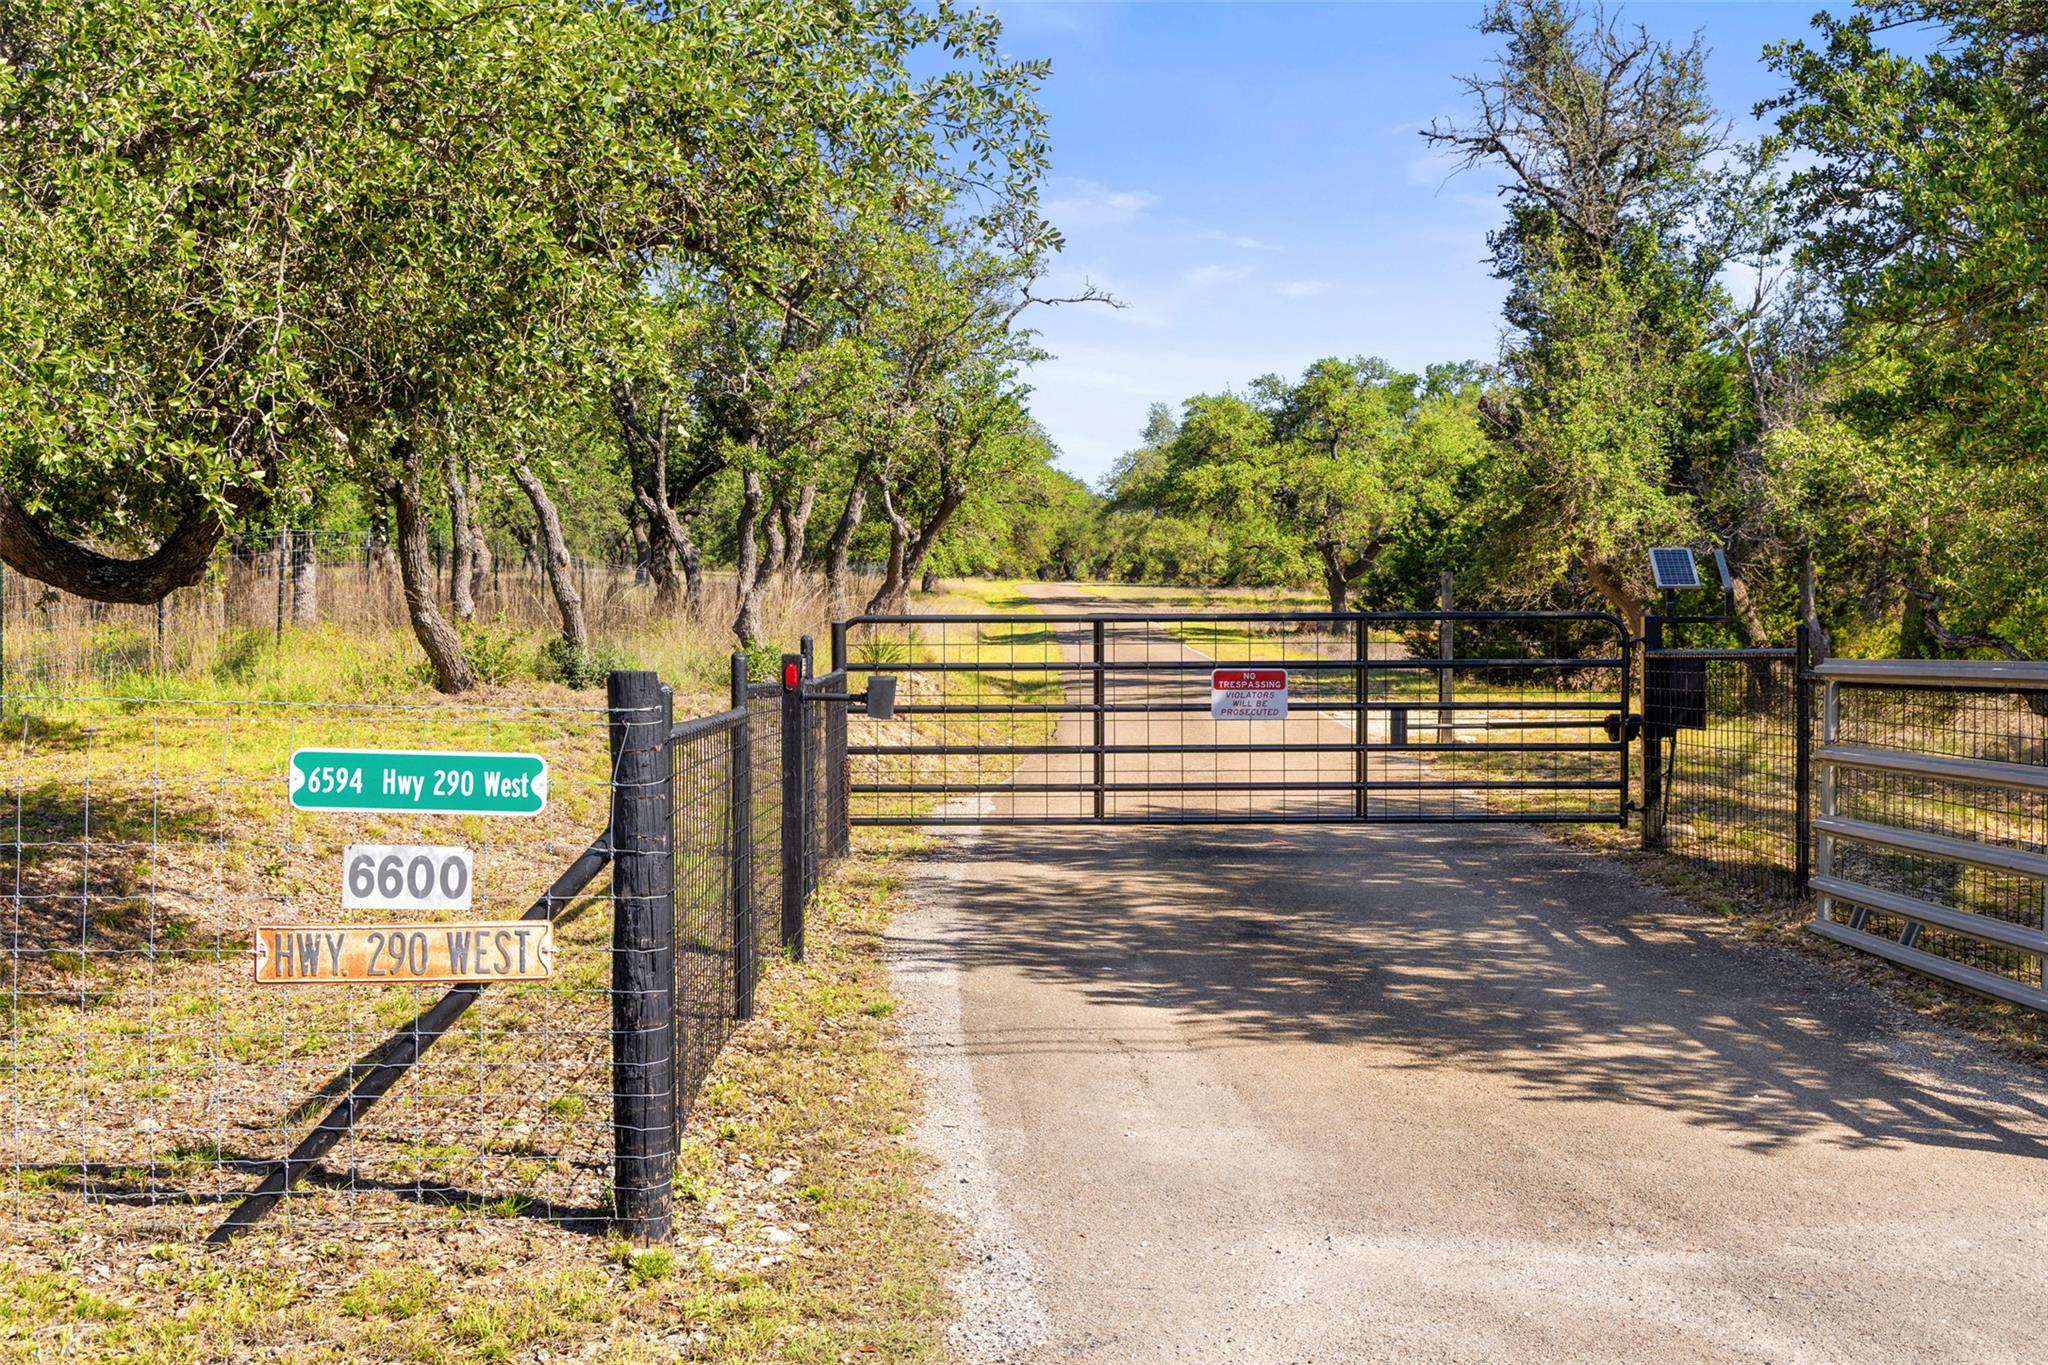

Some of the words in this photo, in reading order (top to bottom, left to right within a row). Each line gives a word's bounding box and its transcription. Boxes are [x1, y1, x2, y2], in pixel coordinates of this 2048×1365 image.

[307, 766, 363, 794] 6594
[382, 768, 425, 802] Hwy
[433, 770, 474, 797] 290
[484, 771, 529, 798] West
[348, 854, 468, 900] 6600
[275, 933, 350, 977] HWY.
[367, 931, 428, 976] 290
[446, 930, 531, 975] WEST
